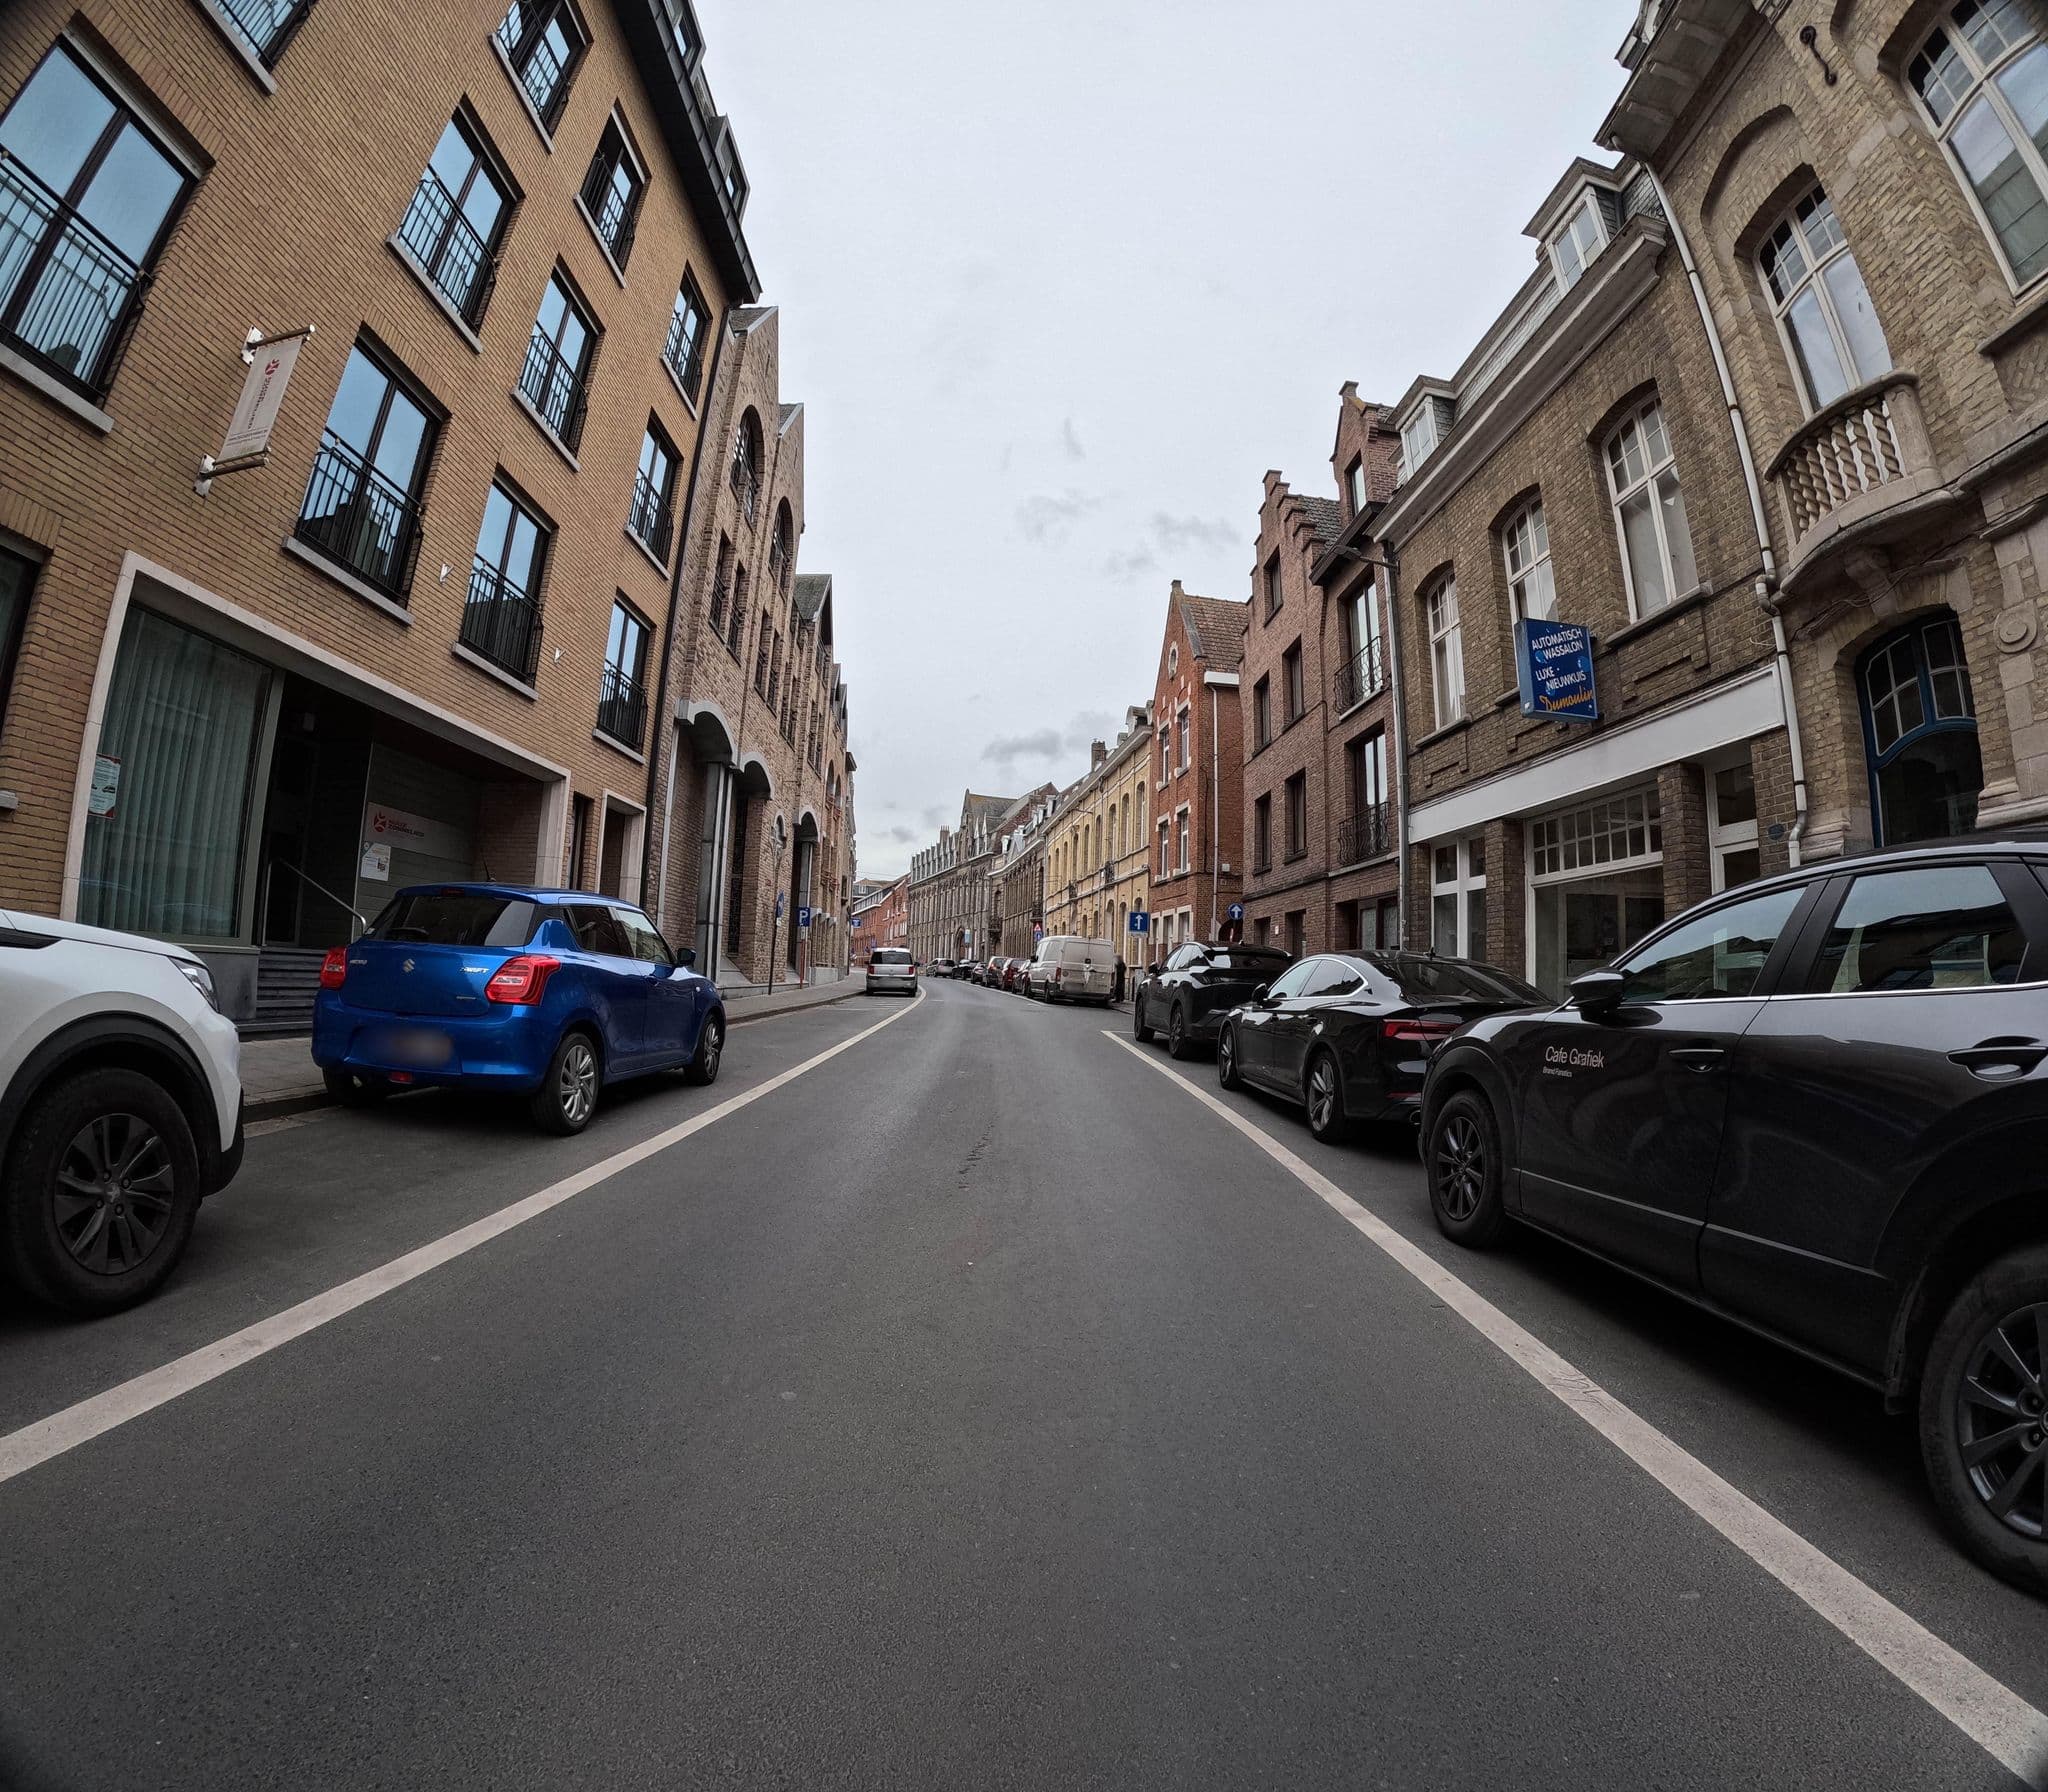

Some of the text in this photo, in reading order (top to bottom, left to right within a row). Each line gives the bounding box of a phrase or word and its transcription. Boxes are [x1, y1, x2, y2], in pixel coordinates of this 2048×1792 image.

[1531, 628, 1583, 650] AUTOMATISCH
[1542, 640, 1584, 660] WASSALON
[1535, 666, 1555, 681] LUXE
[1545, 670, 1587, 691] NIEUWKUIS
[1539, 685, 1593, 712] Dumoulin
[799, 910, 808, 924] P
[1545, 1046, 1605, 1068] Cafe Grafiek
